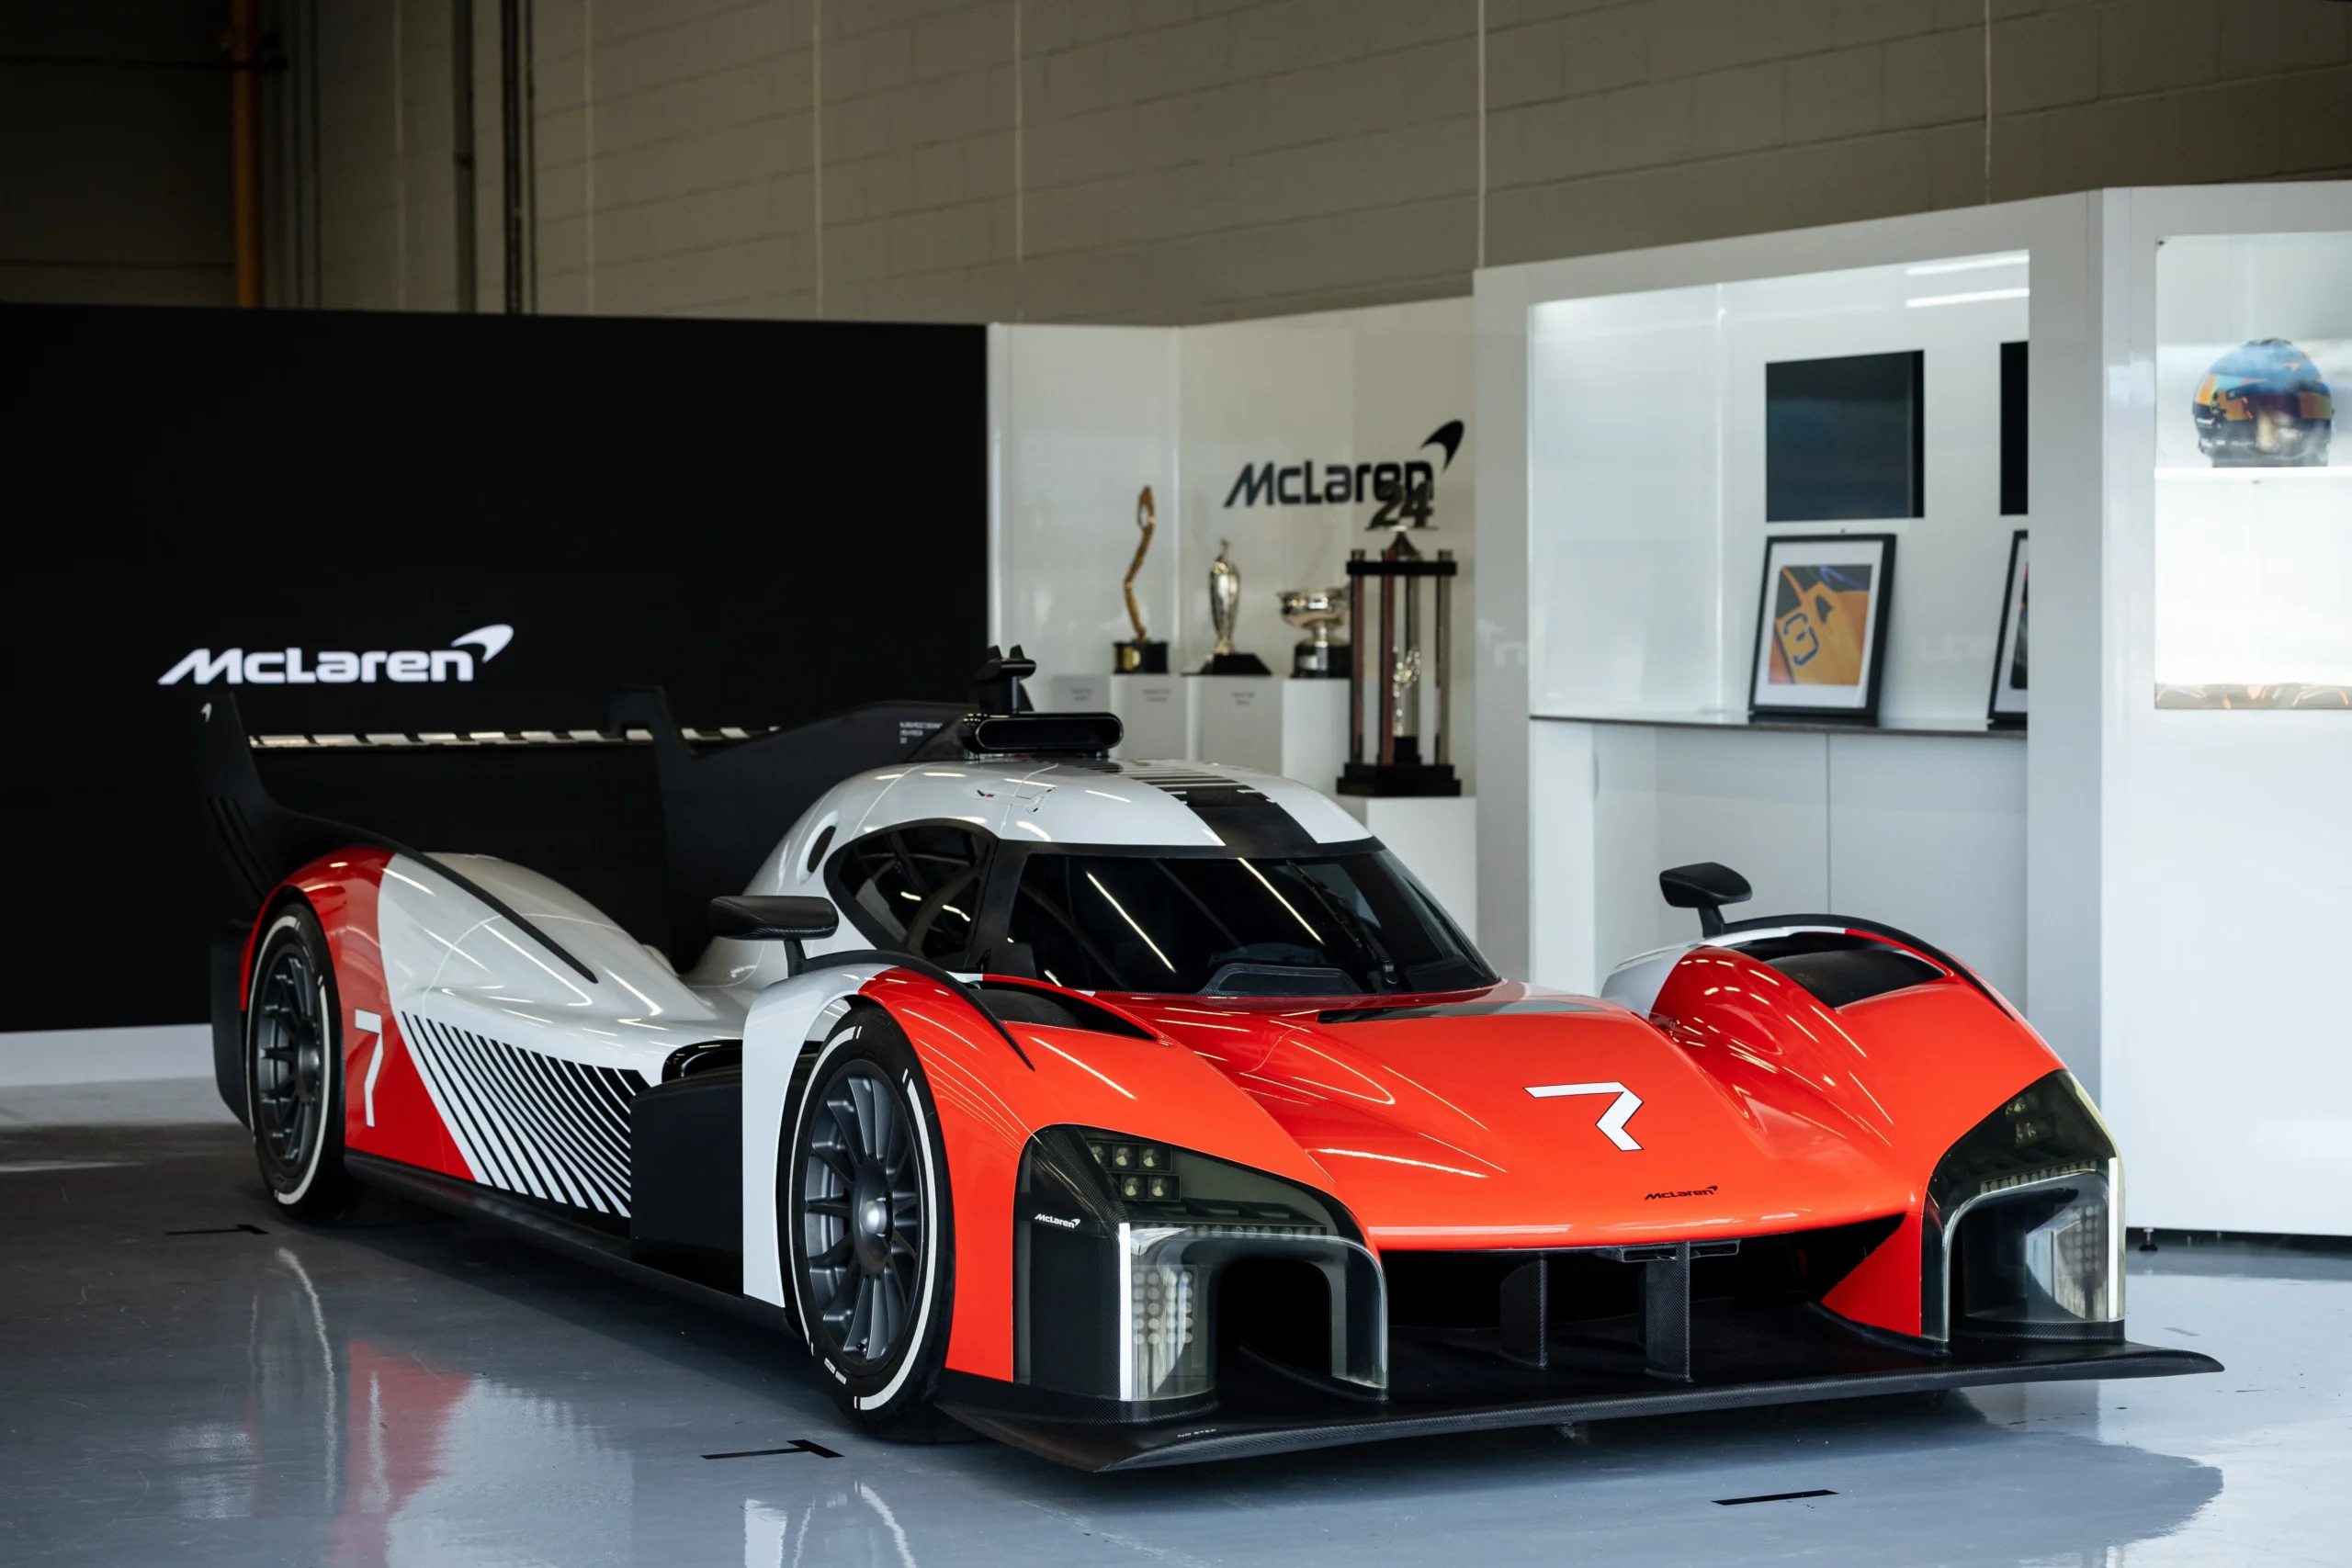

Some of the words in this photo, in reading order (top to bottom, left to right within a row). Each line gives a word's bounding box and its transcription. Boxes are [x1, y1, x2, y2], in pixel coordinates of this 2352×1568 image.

[1369, 479, 1434, 529] 24
[157, 647, 474, 685] McLaren
[354, 1008, 384, 1128] 7
[1644, 1190, 1713, 1201] McLaren
[1034, 1213, 1075, 1229] McLaren
